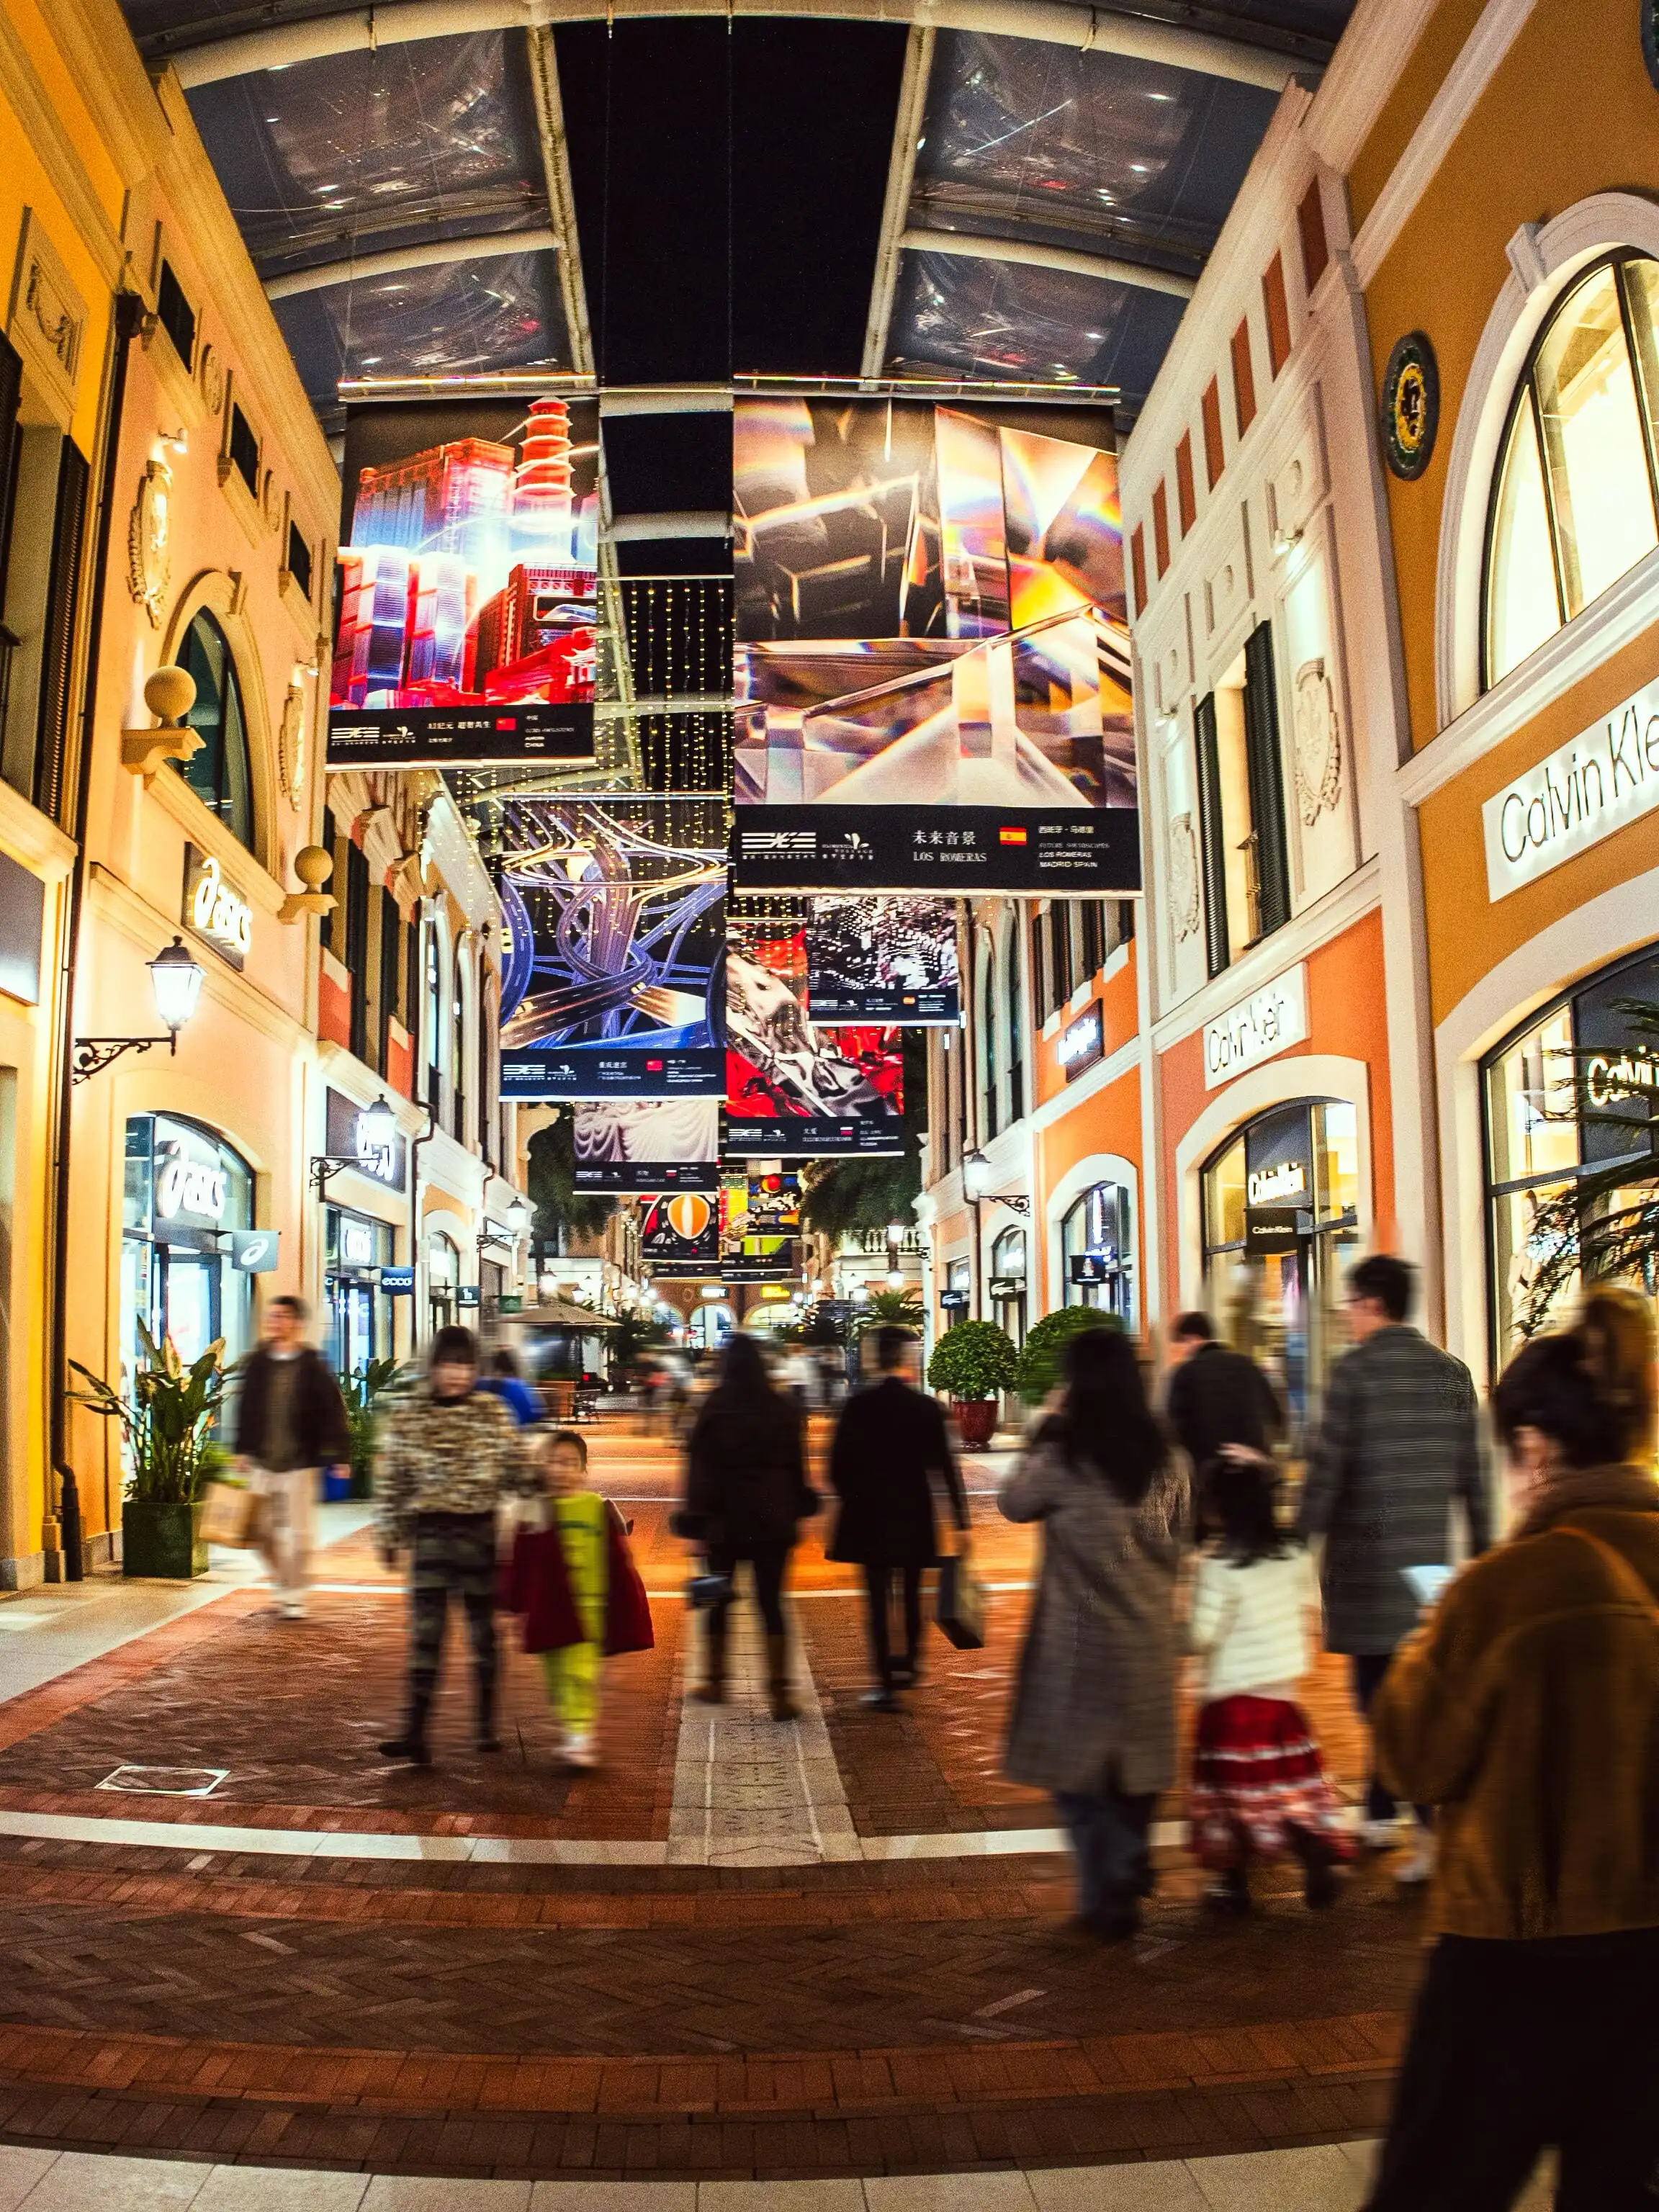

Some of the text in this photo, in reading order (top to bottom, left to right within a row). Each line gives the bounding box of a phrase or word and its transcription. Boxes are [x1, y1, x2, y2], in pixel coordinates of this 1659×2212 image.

[1501, 752, 1604, 862] Calvin
[912, 830, 976, 845] 未来音景
[913, 851, 935, 861] LOS
[382, 1277, 412, 1286] ecco
